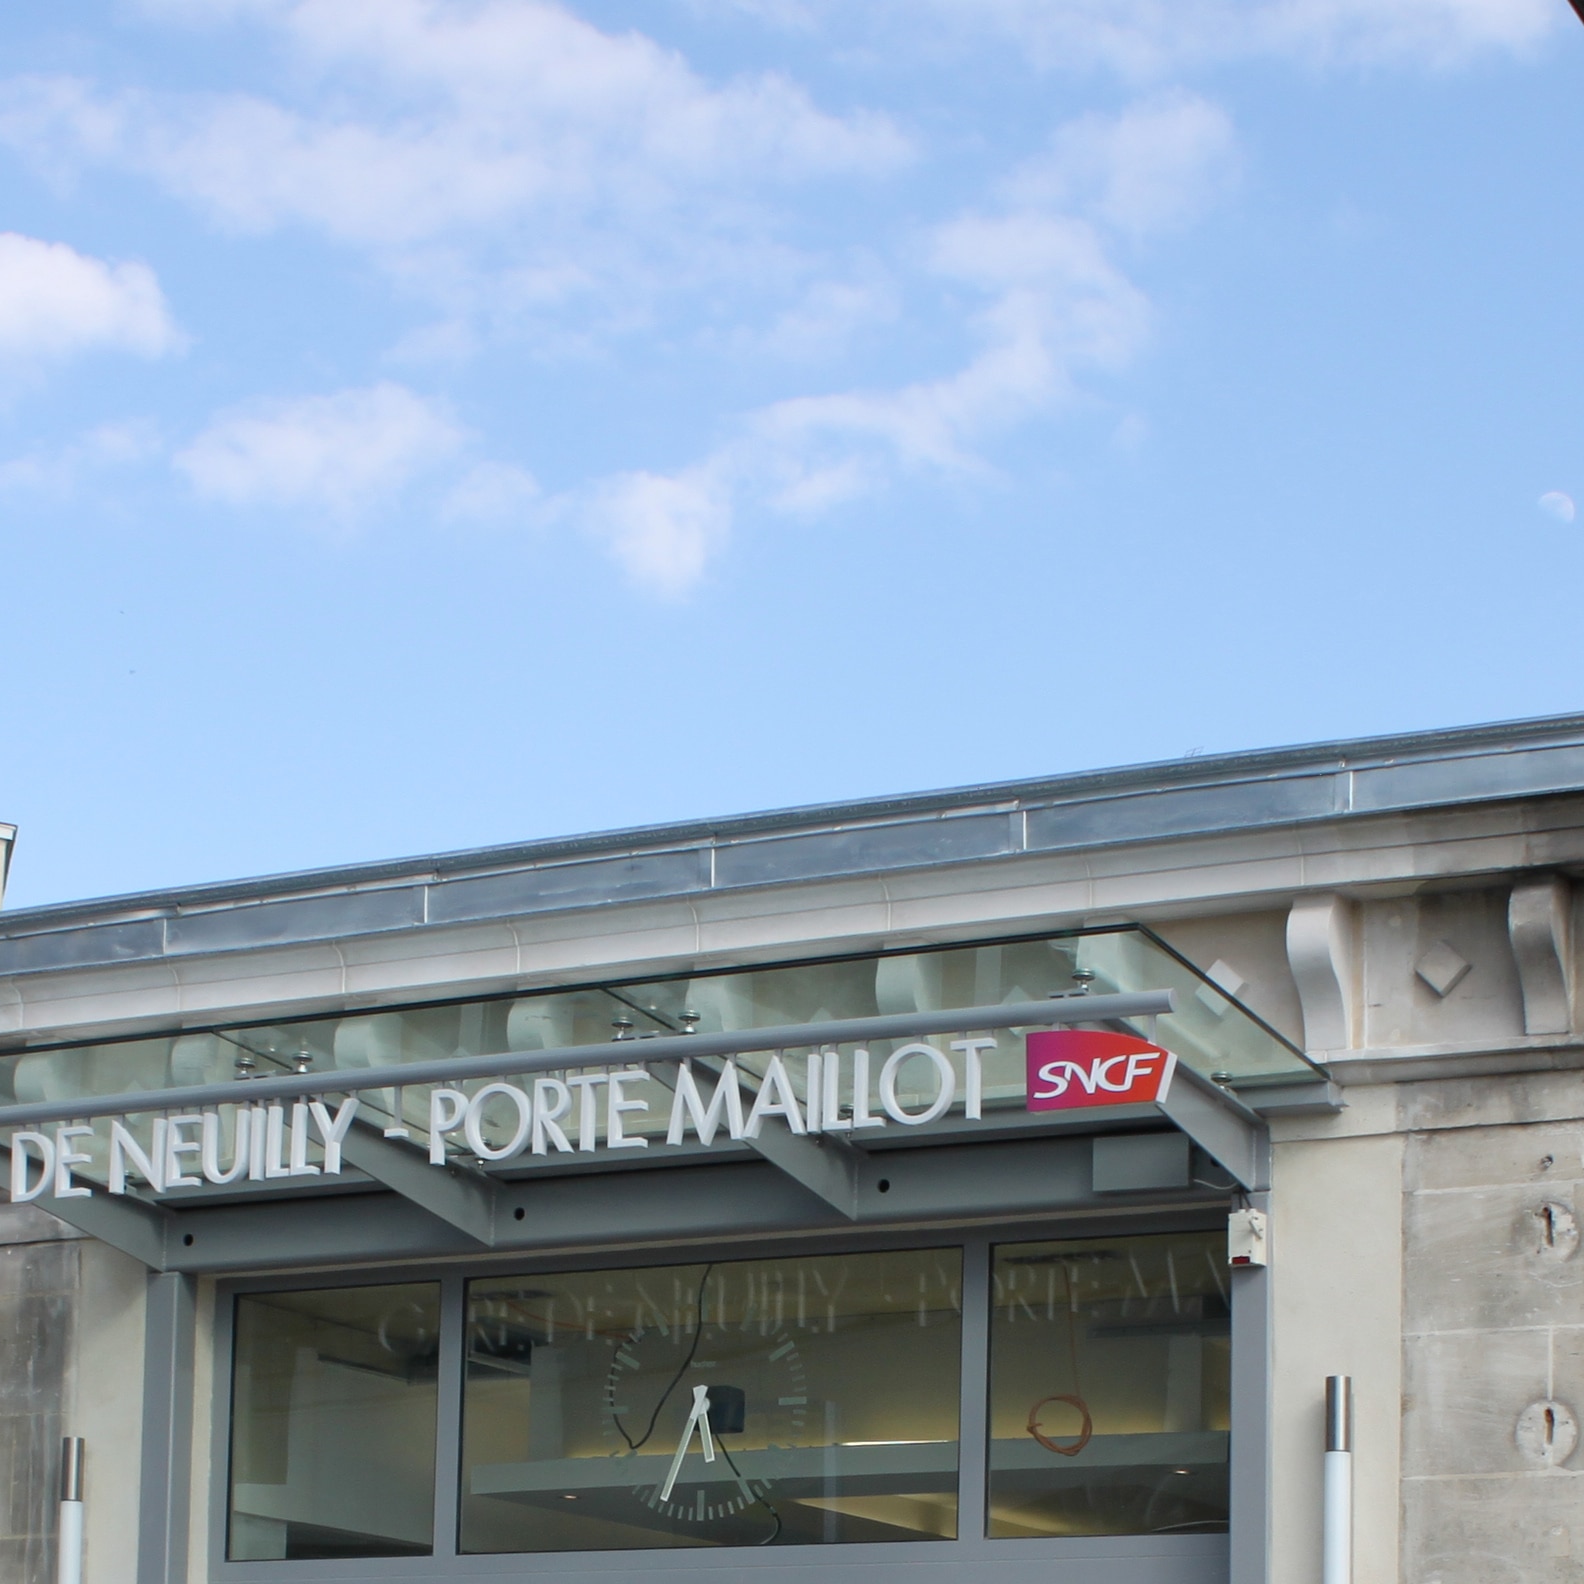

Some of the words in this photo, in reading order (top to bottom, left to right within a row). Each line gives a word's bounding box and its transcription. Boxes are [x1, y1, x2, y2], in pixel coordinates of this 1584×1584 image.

[12, 1123, 93, 1203] DE
[110, 1096, 359, 1195] NEUILLY
[429, 1069, 651, 1165] PORTE
[667, 1036, 998, 1147] MAILLOT
[1032, 1051, 1164, 1100] SNCF
